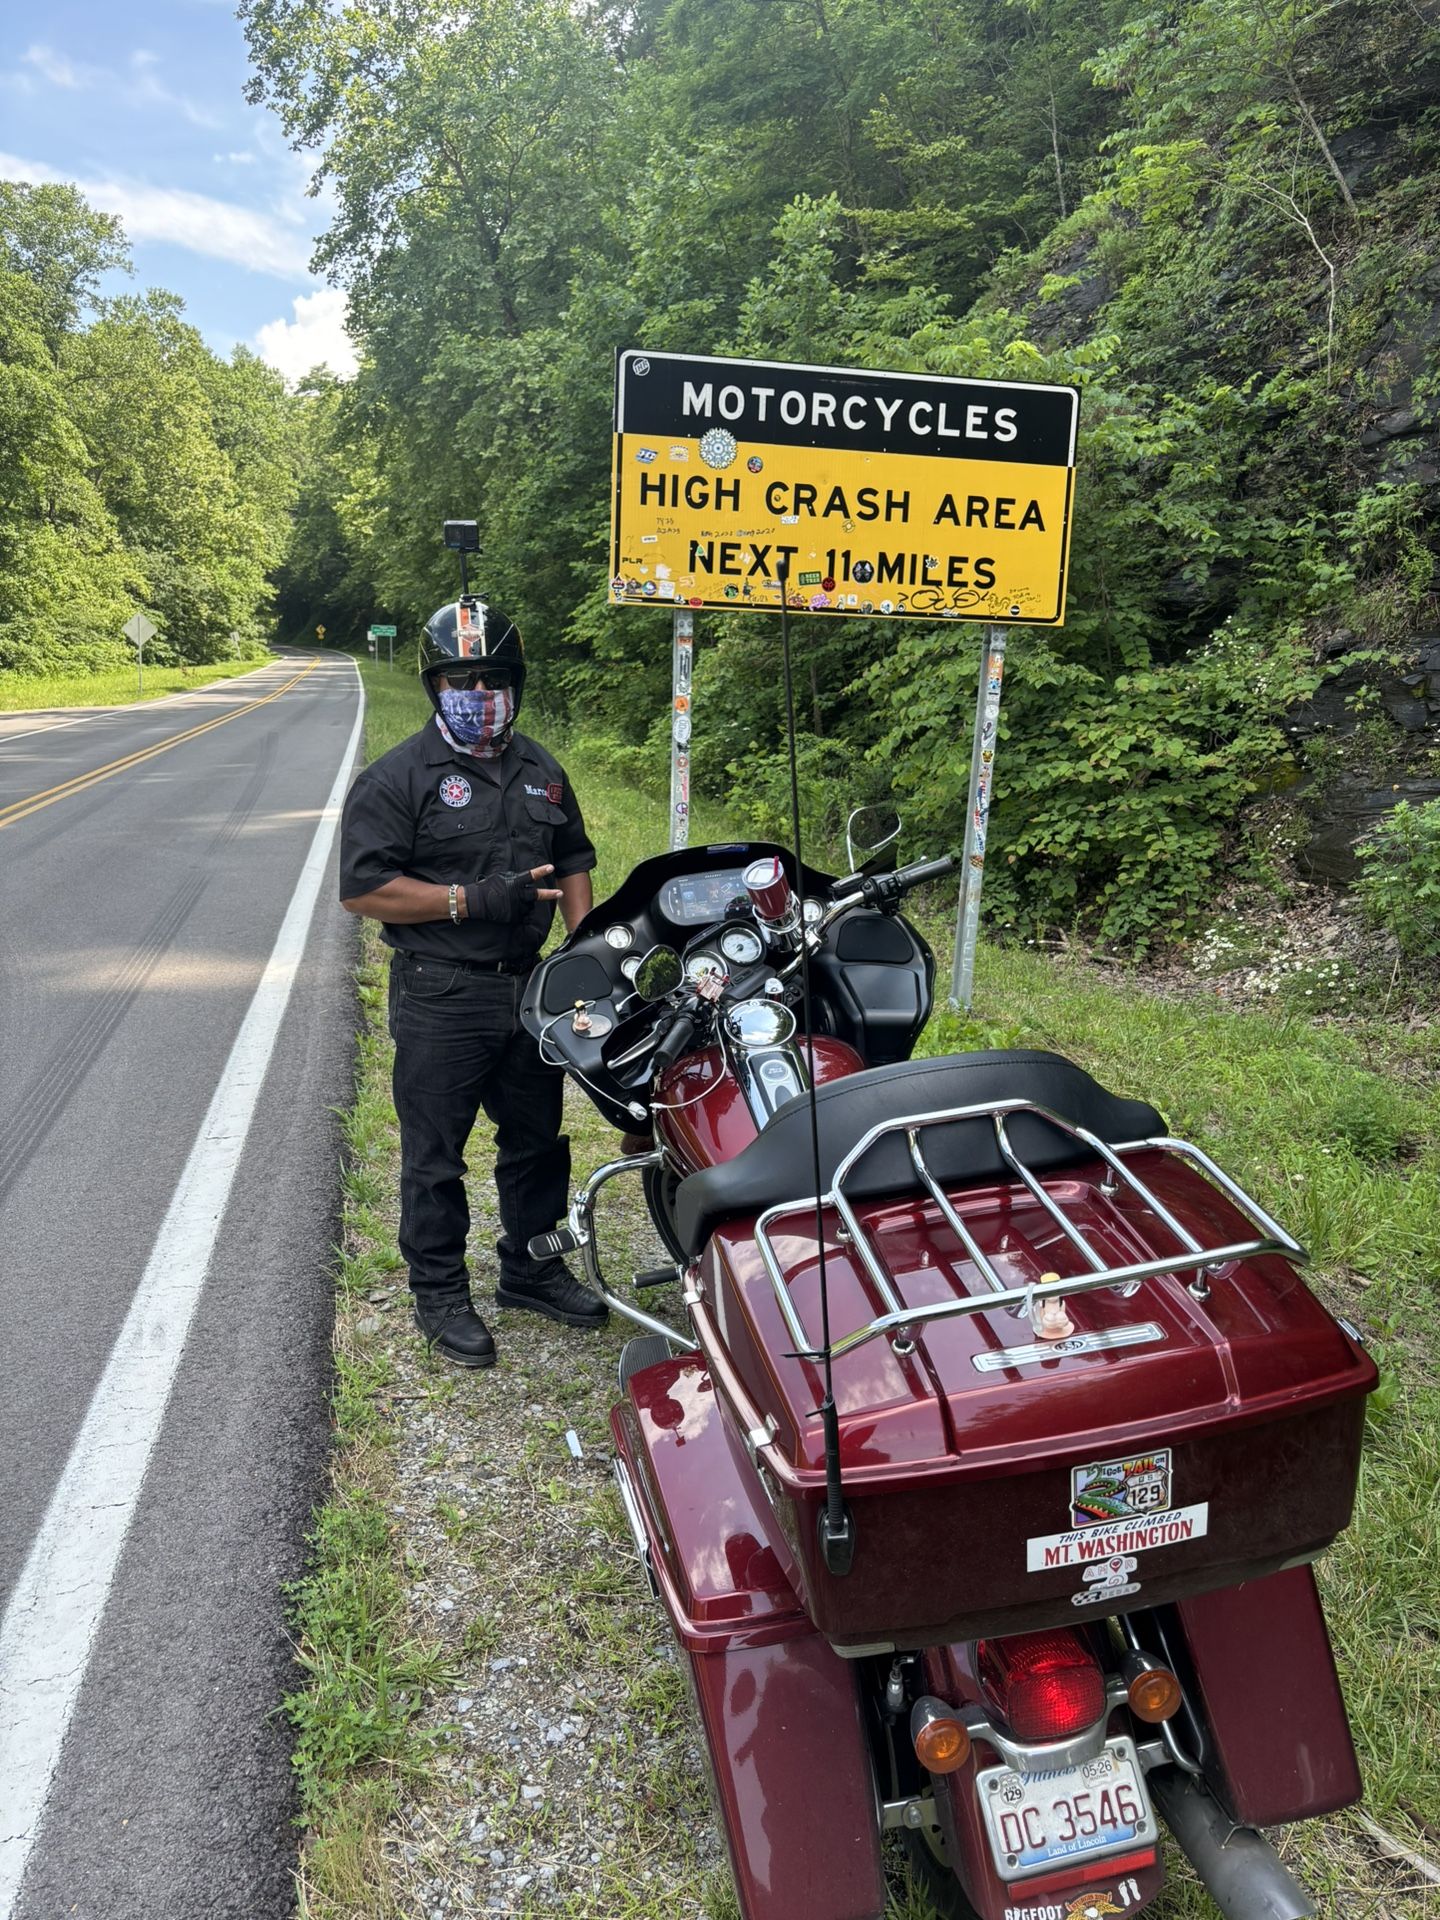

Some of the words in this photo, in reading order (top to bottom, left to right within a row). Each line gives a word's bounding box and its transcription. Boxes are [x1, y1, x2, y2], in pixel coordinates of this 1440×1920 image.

[682, 381, 1018, 442] MOTORCYCLES
[640, 472, 741, 512] HIGH
[765, 481, 911, 523] CRASH
[933, 493, 1046, 533] AREA
[688, 540, 799, 579] NEXT
[826, 549, 852, 582] 11
[877, 551, 996, 590] MILES
[1122, 1456, 1156, 1476] TAIL
[1130, 1484, 1161, 1507] 129
[1044, 1543, 1074, 1567] MT.
[1077, 1518, 1194, 1560] WASHINGTON
[1059, 1531, 1086, 1544] THIS
[1091, 1525, 1119, 1538] BIKE
[1124, 1511, 1182, 1532] CLIMBED
[1003, 1788, 1022, 1803] 129
[1000, 1807, 1047, 1854] DC
[1052, 1784, 1140, 1842] 3546
[1047, 1843, 1067, 1857] Land
[1068, 1841, 1077, 1851] of
[1077, 1835, 1107, 1850] Lincoln
